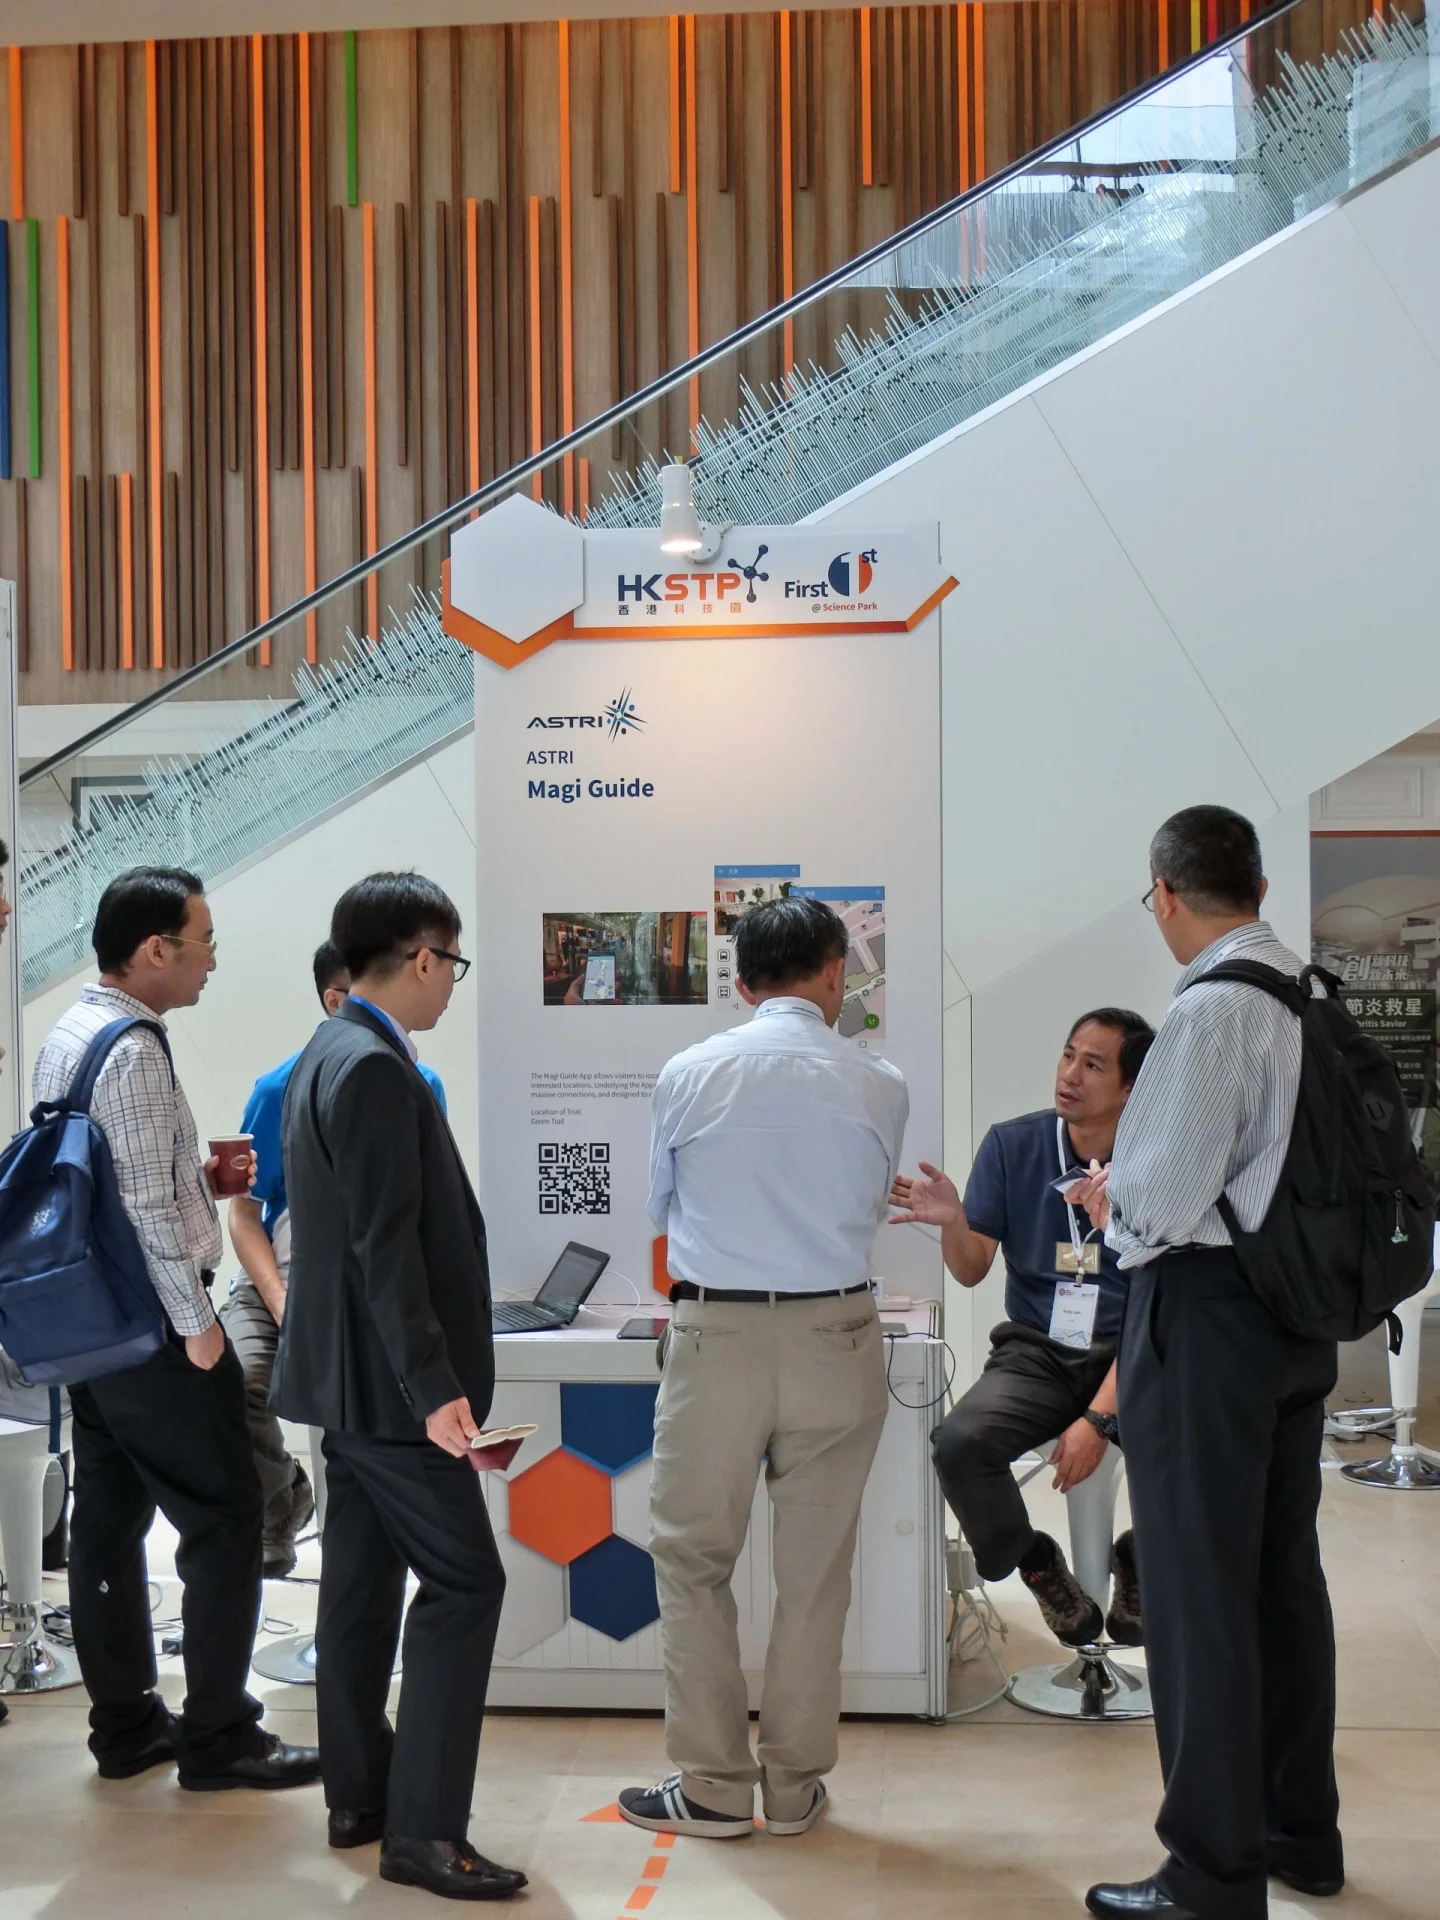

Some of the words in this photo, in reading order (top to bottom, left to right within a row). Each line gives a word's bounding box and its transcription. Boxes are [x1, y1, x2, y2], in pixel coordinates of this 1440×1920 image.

[618, 573, 741, 601] HKSTP
[785, 579, 828, 598] First
[618, 602, 742, 615] 香港科技園
[823, 602, 855, 612] Science
[857, 602, 878, 611] Park
[527, 716, 603, 729] ASTRI
[527, 750, 573, 764] ASTRI
[528, 778, 581, 803] Magi
[588, 777, 655, 798] Guide
[1345, 998, 1423, 1016] 節炎救星
[1380, 1019, 1407, 1028] Savior
[531, 1072, 543, 1080] The
[544, 1072, 559, 1081] Magi
[560, 1072, 579, 1080] Guide
[580, 1072, 593, 1082] App
[594, 1072, 614, 1080] allows
[615, 1072, 637, 1080] visitors
[637, 1072, 644, 1080] to
[531, 1082, 562, 1090] interested
[563, 1082, 594, 1090] locations.
[594, 1082, 629, 1091] Underlying
[641, 1082, 654, 1091] App
[557, 1091, 597, 1099] connections,
[612, 1091, 640, 1100] designed
[531, 1108, 559, 1116] Location
[559, 1108, 566, 1116] of
[531, 1117, 550, 1125] Green
[551, 1117, 565, 1125] Trail
